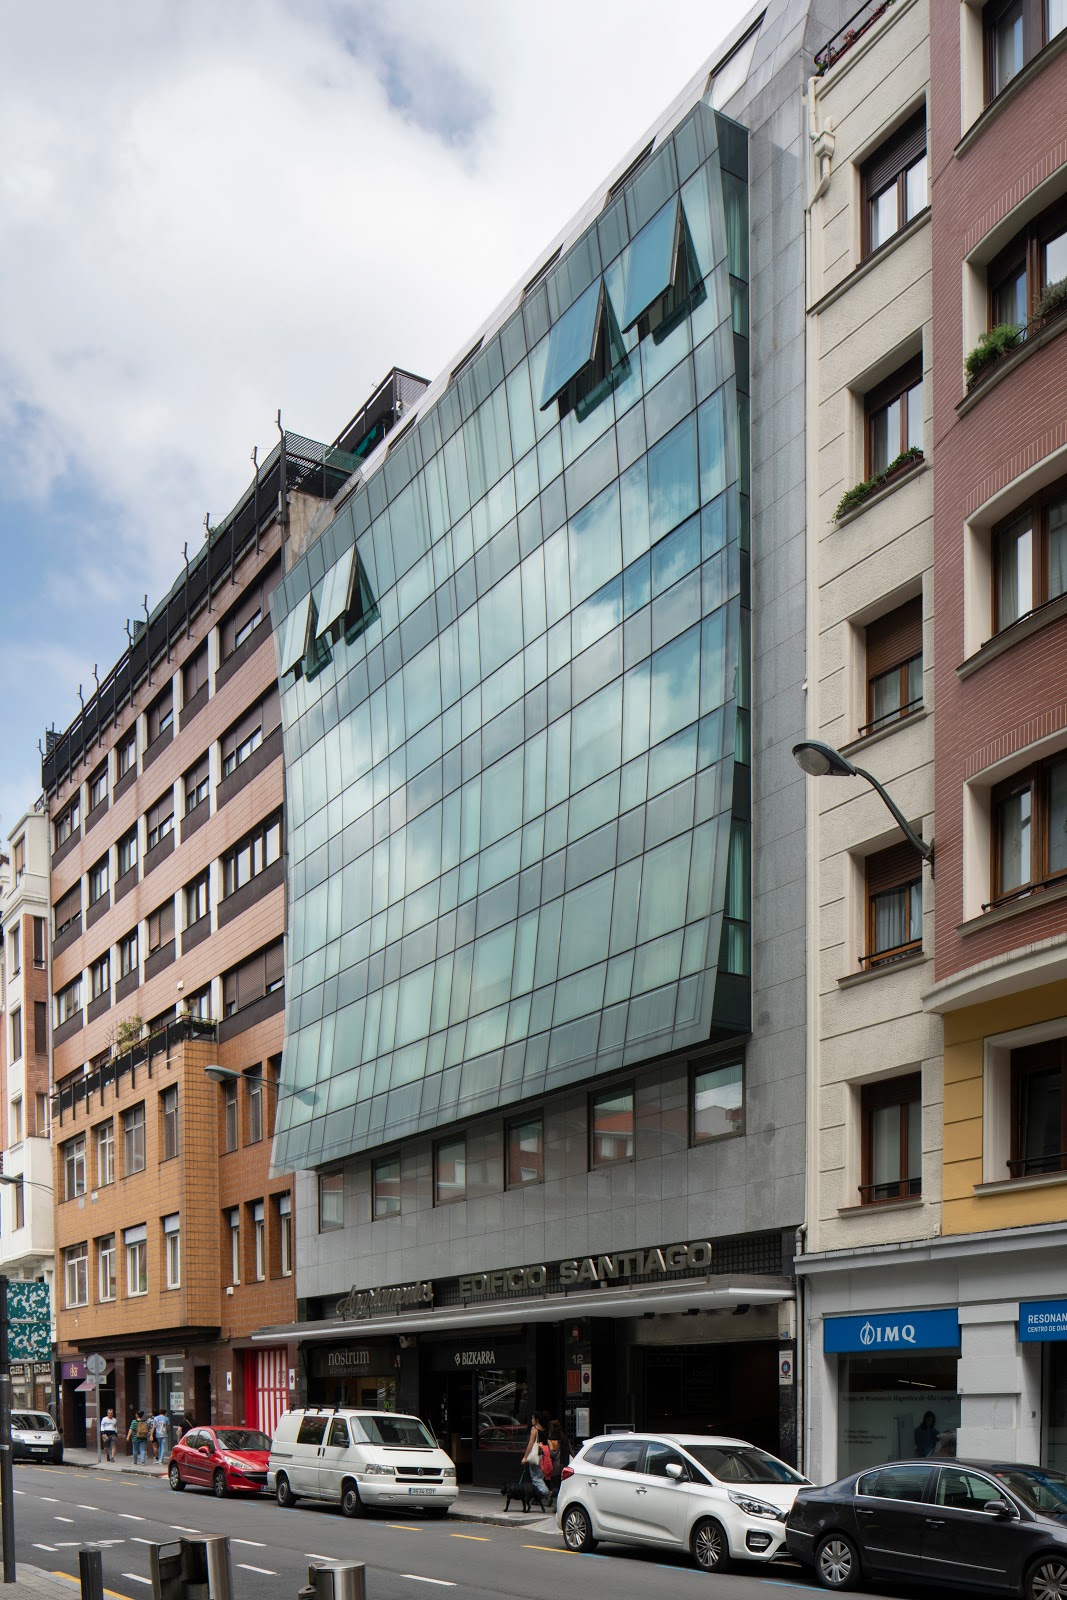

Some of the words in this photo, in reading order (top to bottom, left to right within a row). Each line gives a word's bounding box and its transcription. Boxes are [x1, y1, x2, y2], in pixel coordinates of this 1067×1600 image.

[459, 1265, 547, 1297] EDIFICIO
[559, 1241, 712, 1285] SANTIAGO
[876, 1324, 916, 1343] IMQ
[328, 1348, 370, 1366] nostrum
[462, 1350, 496, 1366] BIZKARRA
[571, 1354, 584, 1364] 12
